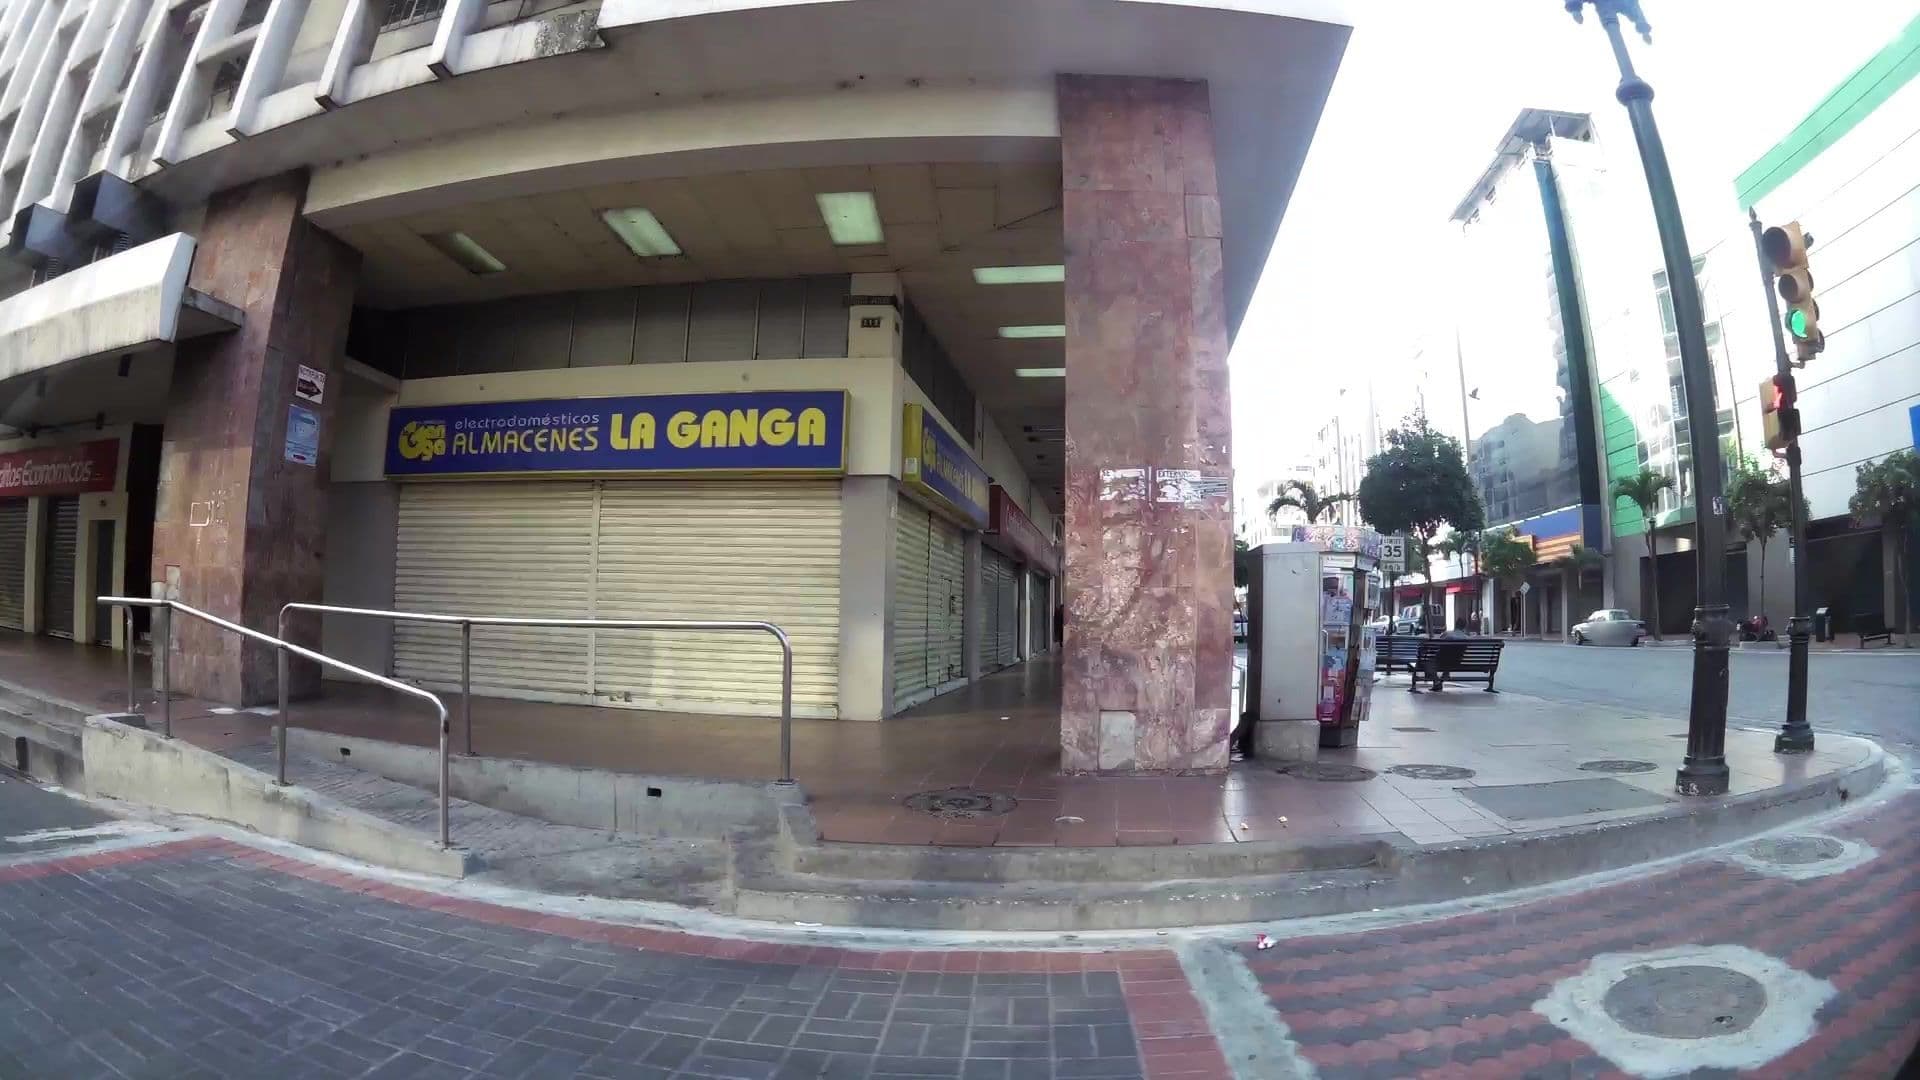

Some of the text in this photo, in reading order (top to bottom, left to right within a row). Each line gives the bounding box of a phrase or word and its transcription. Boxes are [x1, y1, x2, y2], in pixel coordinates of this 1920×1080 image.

[454, 413, 600, 430] electrodomésticos
[610, 407, 826, 450] LA GANGA
[452, 426, 599, 456] ALMACENES
[1383, 545, 1402, 557] 35
